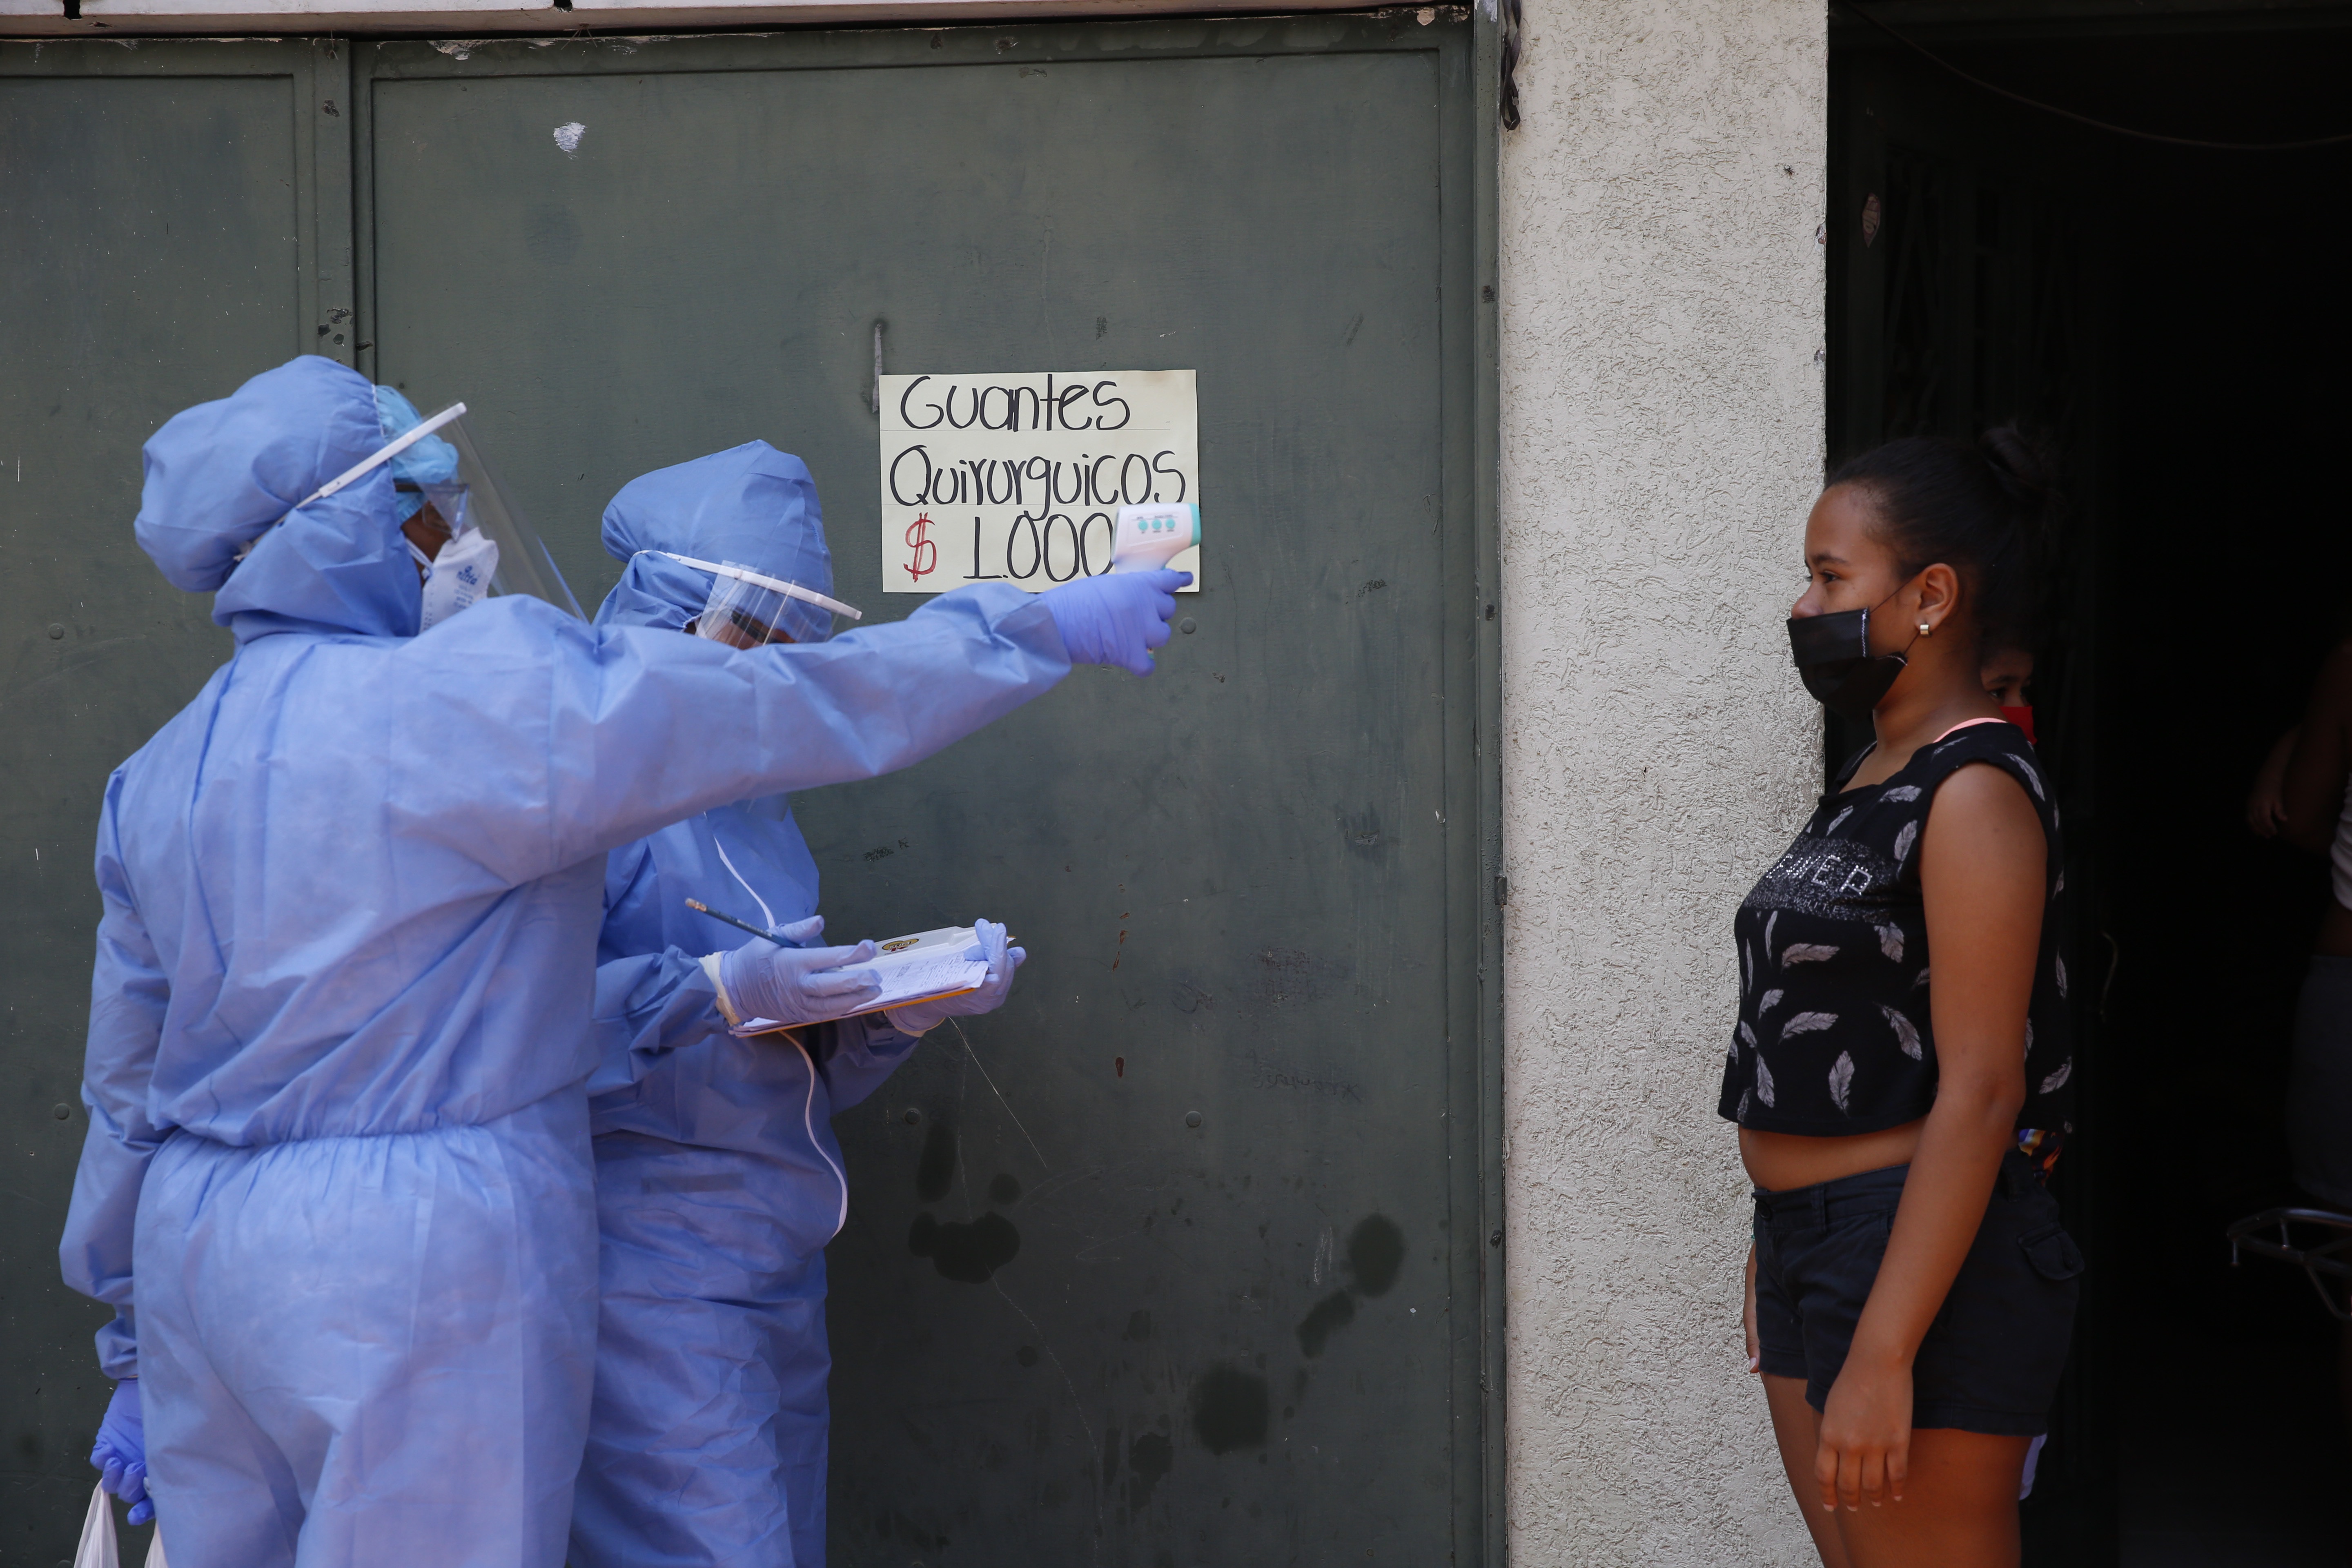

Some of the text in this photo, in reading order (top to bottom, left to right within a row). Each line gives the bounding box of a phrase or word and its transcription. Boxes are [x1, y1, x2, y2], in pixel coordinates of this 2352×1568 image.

[900, 373, 1131, 432] Guantes
[889, 444, 1186, 521] Quirurguicos
[903, 510, 1114, 583] $ 1.000
[1793, 895, 1840, 913] WHITE
